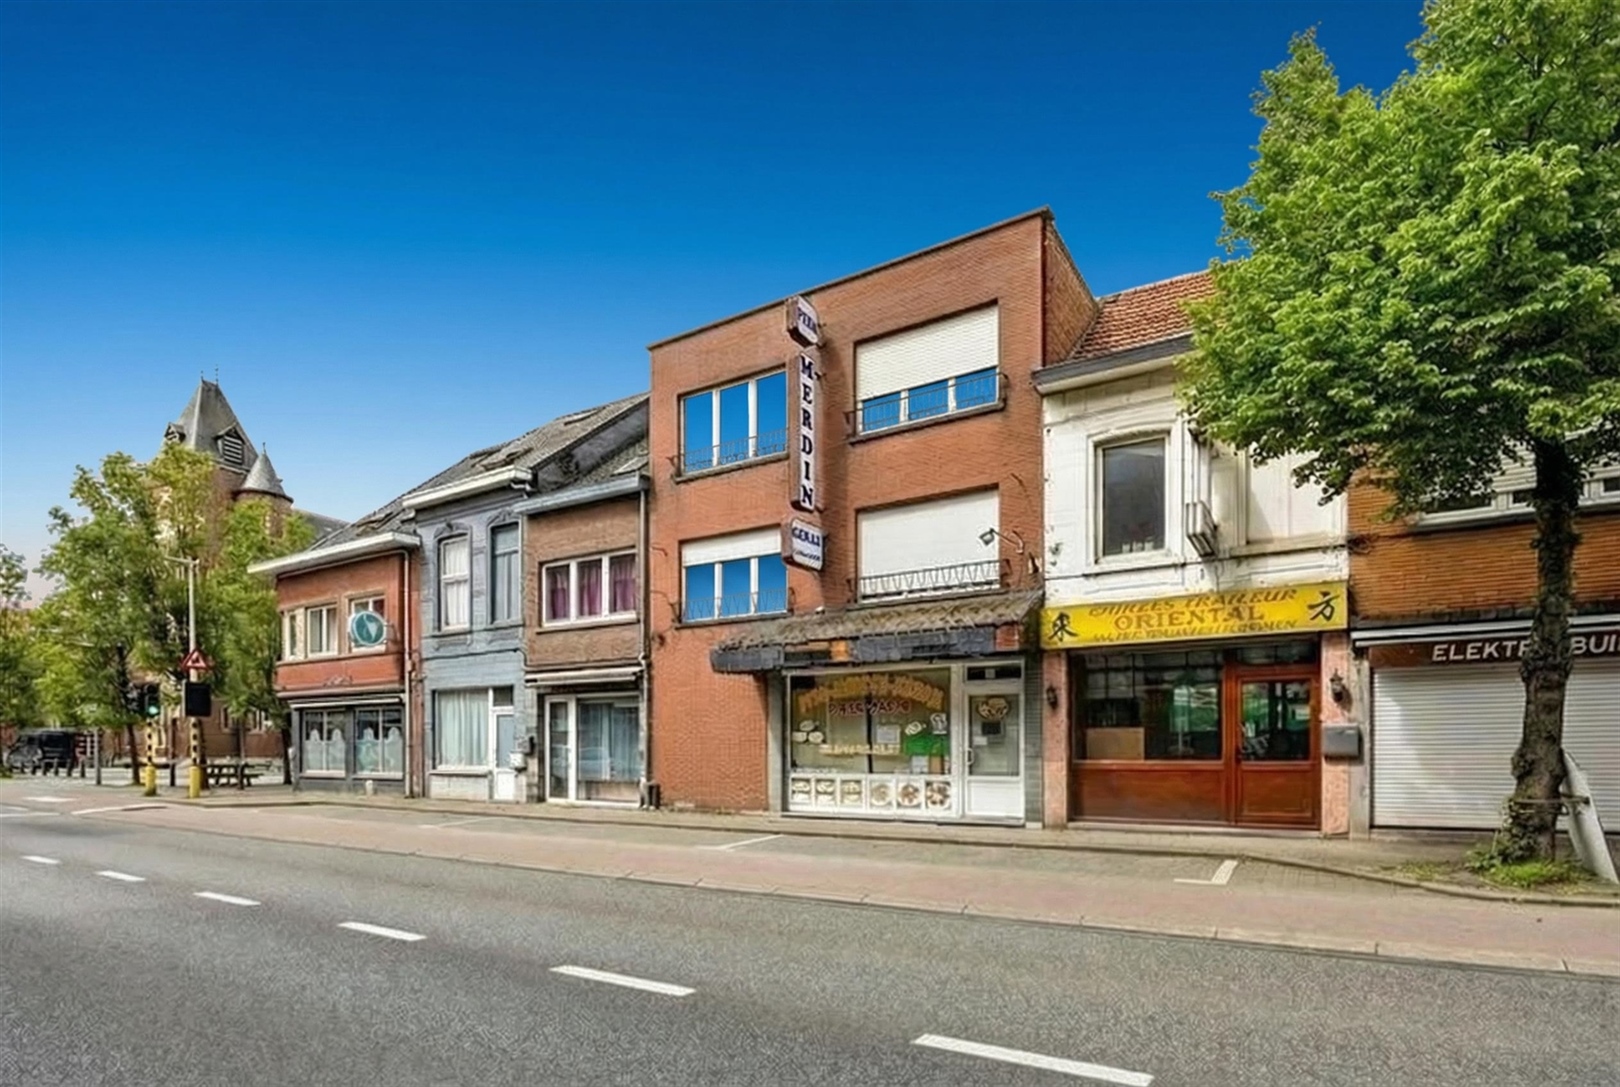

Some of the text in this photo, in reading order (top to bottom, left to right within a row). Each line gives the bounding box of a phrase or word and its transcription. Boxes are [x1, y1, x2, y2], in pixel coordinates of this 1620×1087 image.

[801, 355, 814, 507] MERDIN
[1113, 605, 1265, 631] ORIENTAL
[1307, 590, 1340, 622] 方
[1570, 634, 1620, 655] BUI
